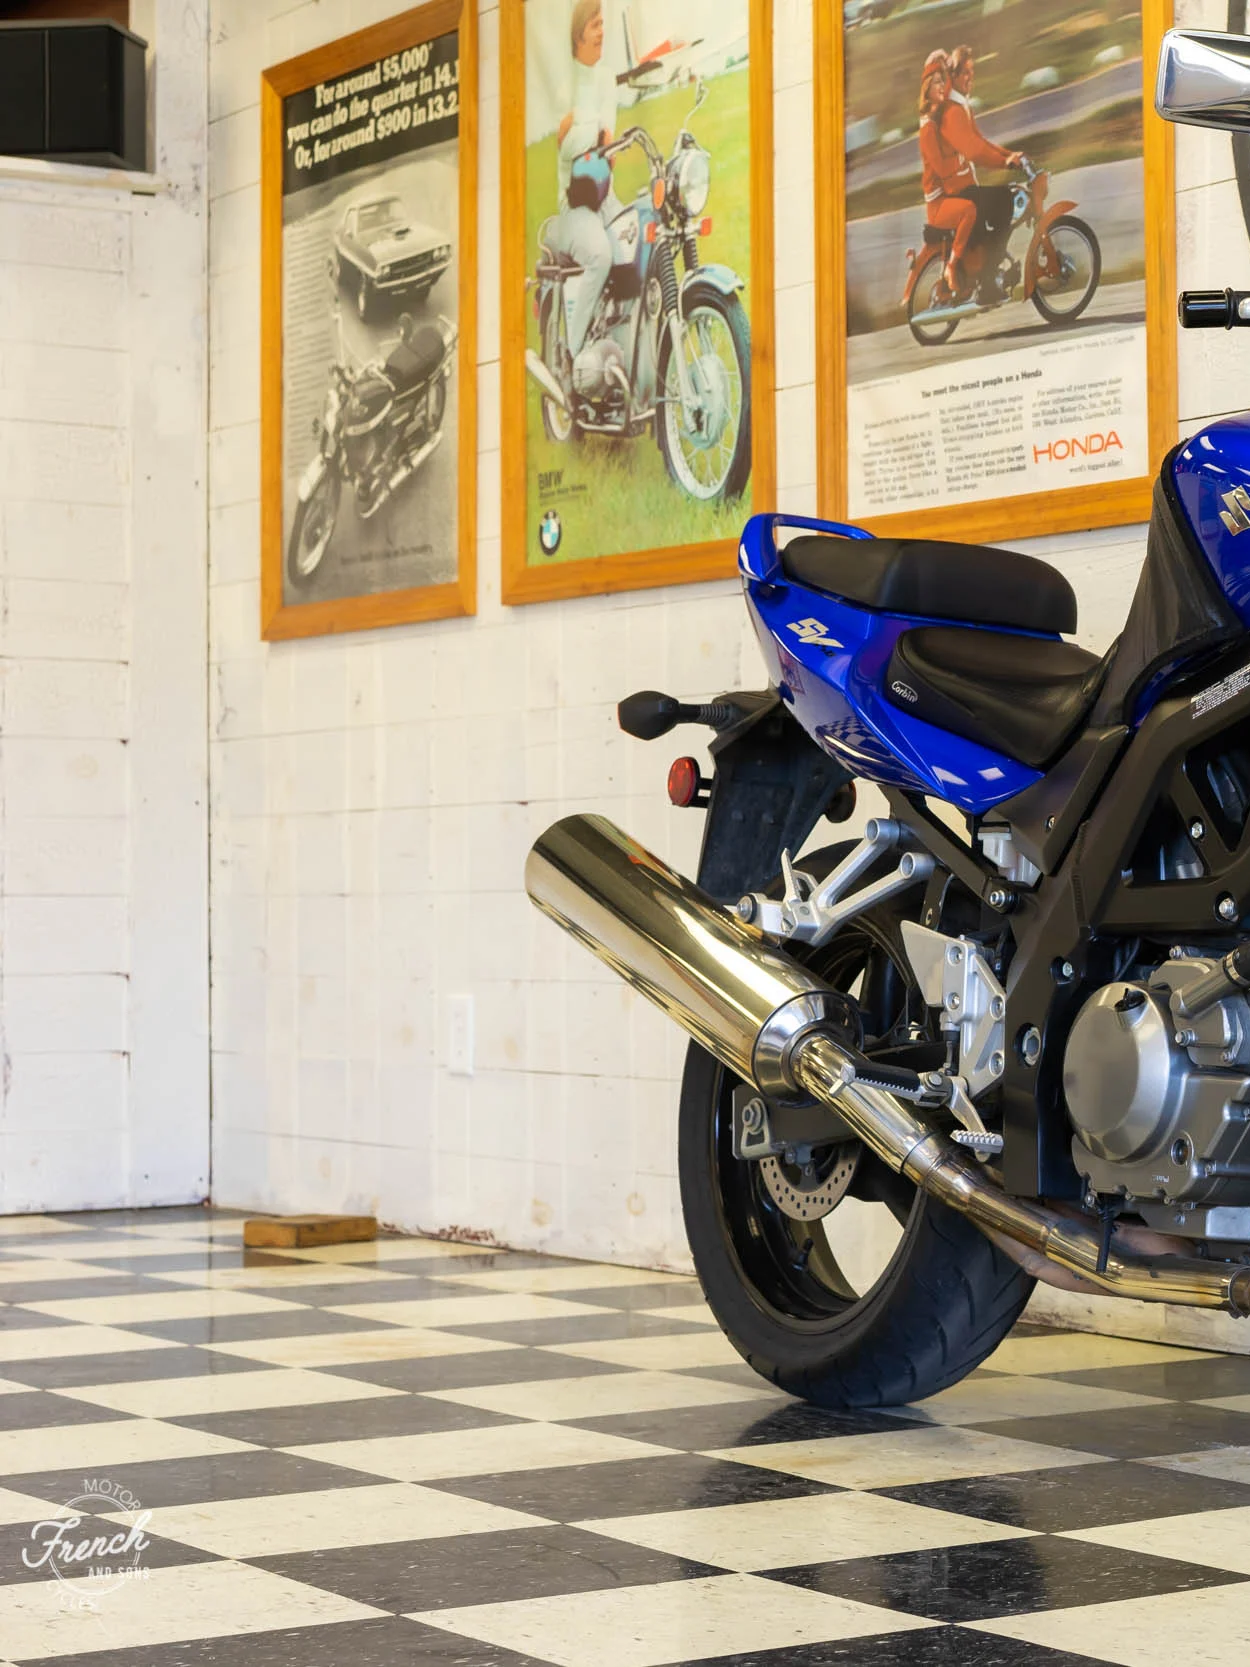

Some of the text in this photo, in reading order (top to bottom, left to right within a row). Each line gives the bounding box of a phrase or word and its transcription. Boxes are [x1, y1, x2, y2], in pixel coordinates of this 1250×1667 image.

[315, 83, 334, 108] For
[335, 62, 381, 98] around
[287, 121, 309, 149] you
[310, 111, 332, 136] can
[333, 103, 348, 126] do
[350, 96, 369, 121] the
[371, 80, 417, 116] quarter
[419, 72, 432, 95] in
[294, 145, 313, 170] Or,
[314, 139, 331, 163] for
[332, 118, 375, 155] around
[377, 106, 411, 140] $900
[412, 103, 426, 127] in
[1033, 430, 1123, 464] HONDA
[786, 617, 845, 649] SV
[892, 681, 915, 702] Corbin
